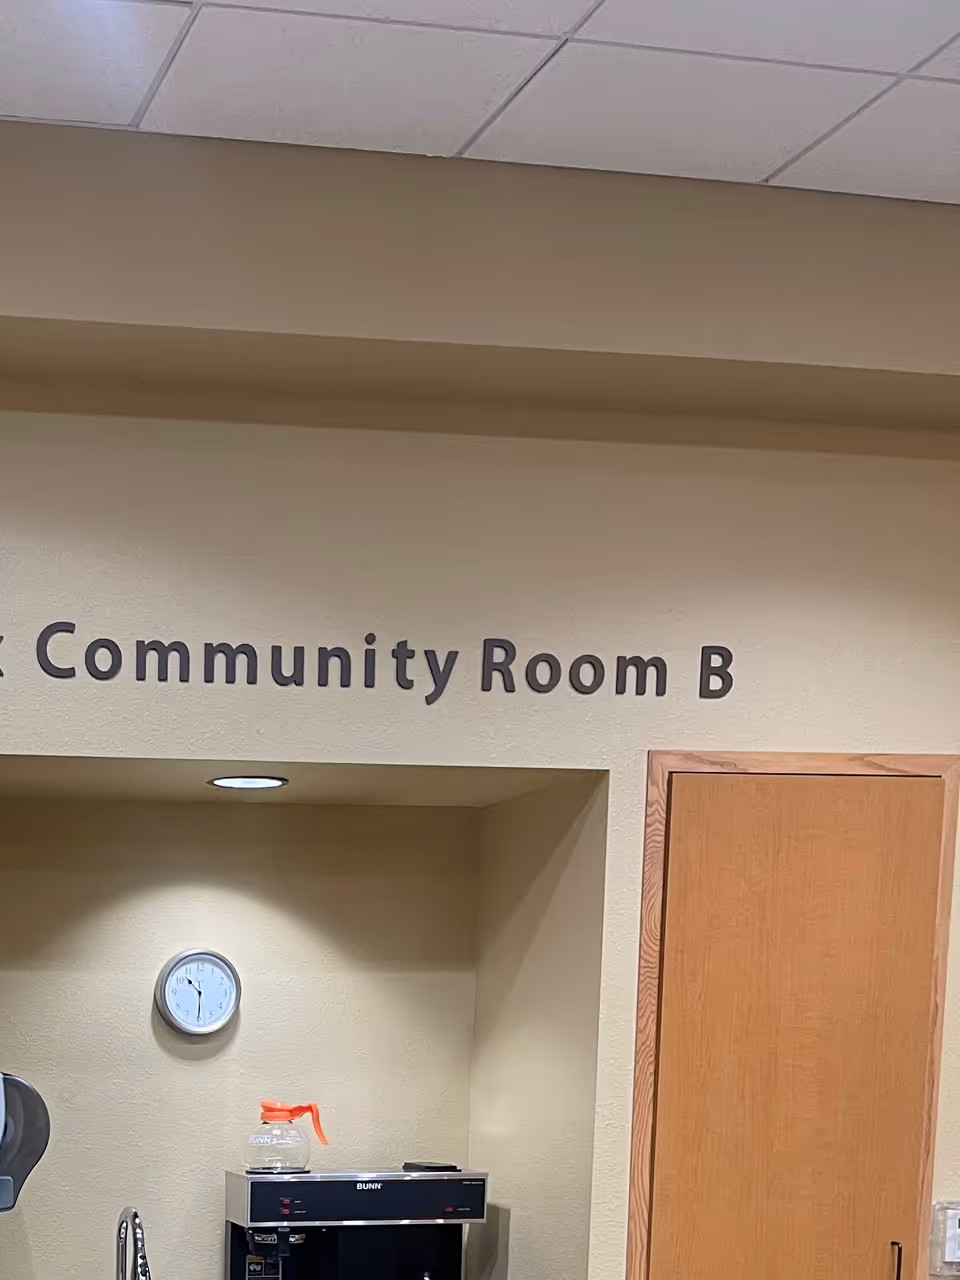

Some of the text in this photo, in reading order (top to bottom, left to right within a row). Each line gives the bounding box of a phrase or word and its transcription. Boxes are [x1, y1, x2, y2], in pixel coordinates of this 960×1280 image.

[36, 621, 459, 705] Community
[481, 638, 667, 697] Room
[699, 645, 734, 699] B
[185, 966, 192, 975] 11
[196, 963, 205, 972] 12
[176, 976, 184, 985] 10
[219, 976, 224, 985] 2
[172, 988, 177, 996] 9
[223, 988, 227, 997] 3
[185, 1010, 189, 1018] 7
[356, 1182, 382, 1190] BUNN
